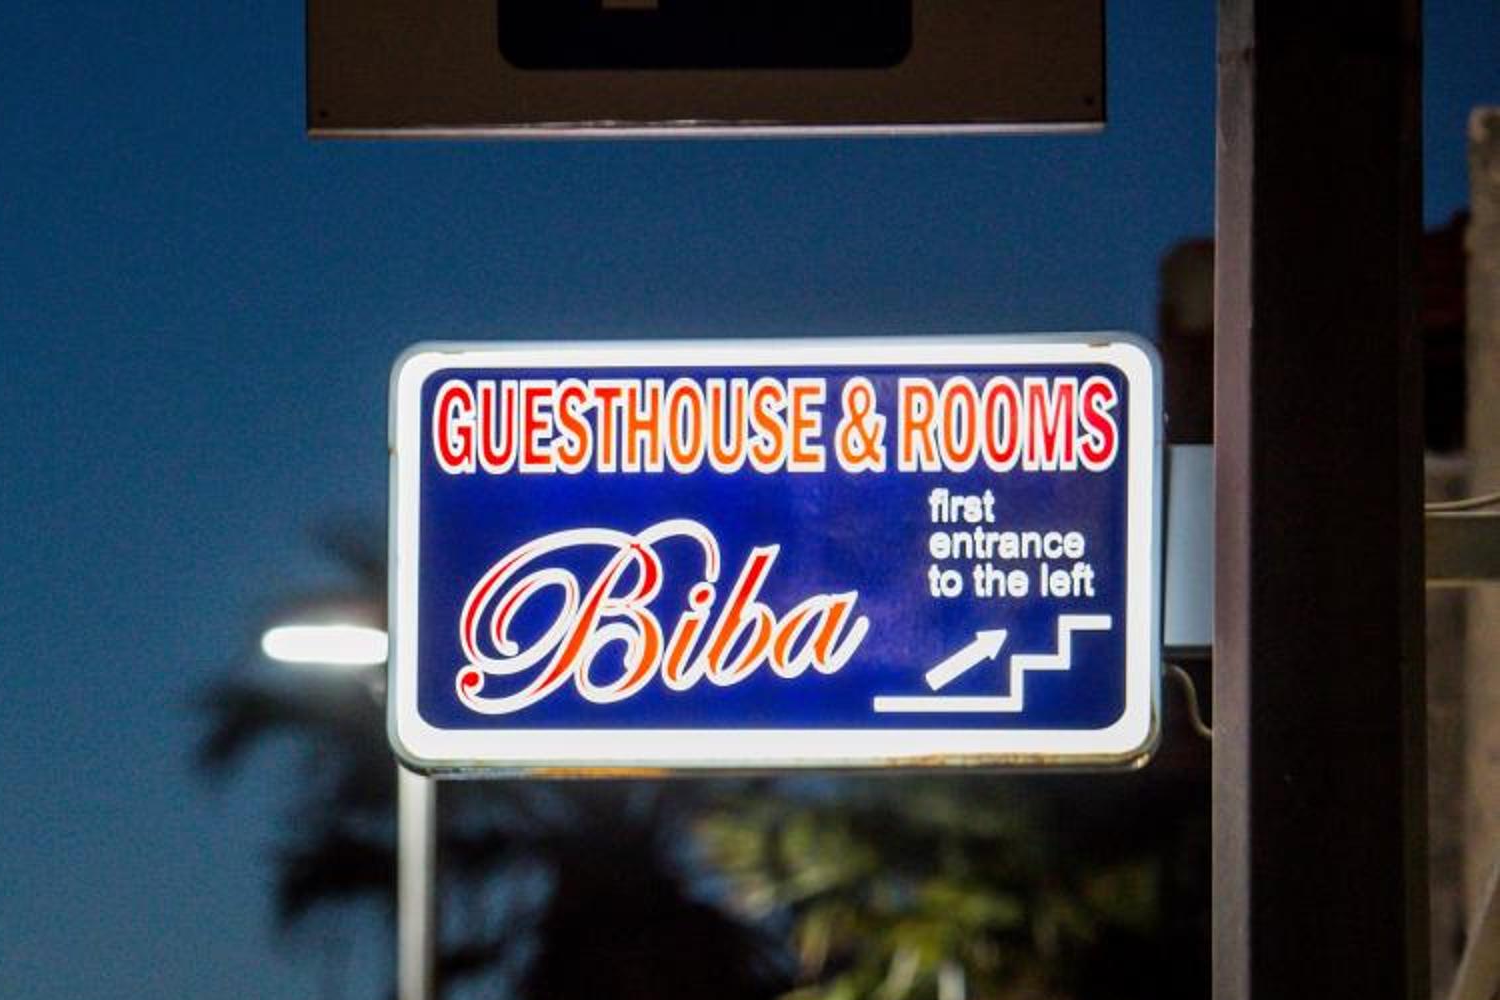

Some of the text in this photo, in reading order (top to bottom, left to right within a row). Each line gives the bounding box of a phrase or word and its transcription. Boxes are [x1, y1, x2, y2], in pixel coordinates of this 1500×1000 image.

[433, 375, 1119, 474] GUESTHOUSE & ROOMS
[928, 488, 996, 523] first
[928, 526, 1086, 559] entrance
[928, 562, 1095, 598] to the left
[455, 518, 869, 714] Biba
